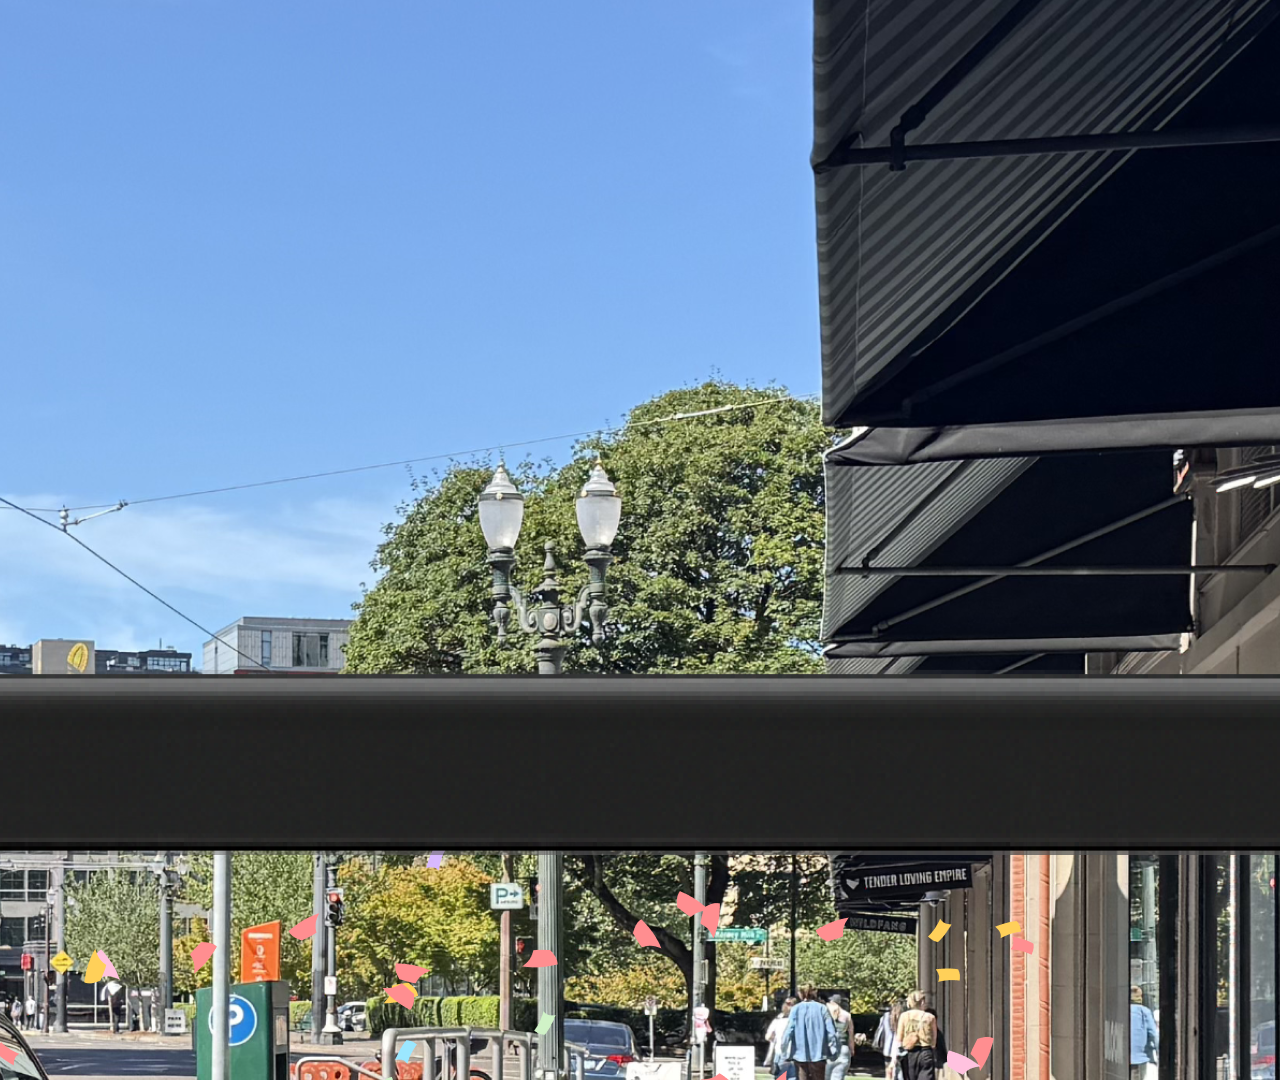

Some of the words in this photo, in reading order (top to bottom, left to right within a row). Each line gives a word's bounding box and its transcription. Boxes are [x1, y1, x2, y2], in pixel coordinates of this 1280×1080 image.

[863, 873, 898, 889] TENDER
[899, 870, 932, 886] LOVING
[933, 867, 967, 883] EMPIRE
[495, 887, 509, 904] P
